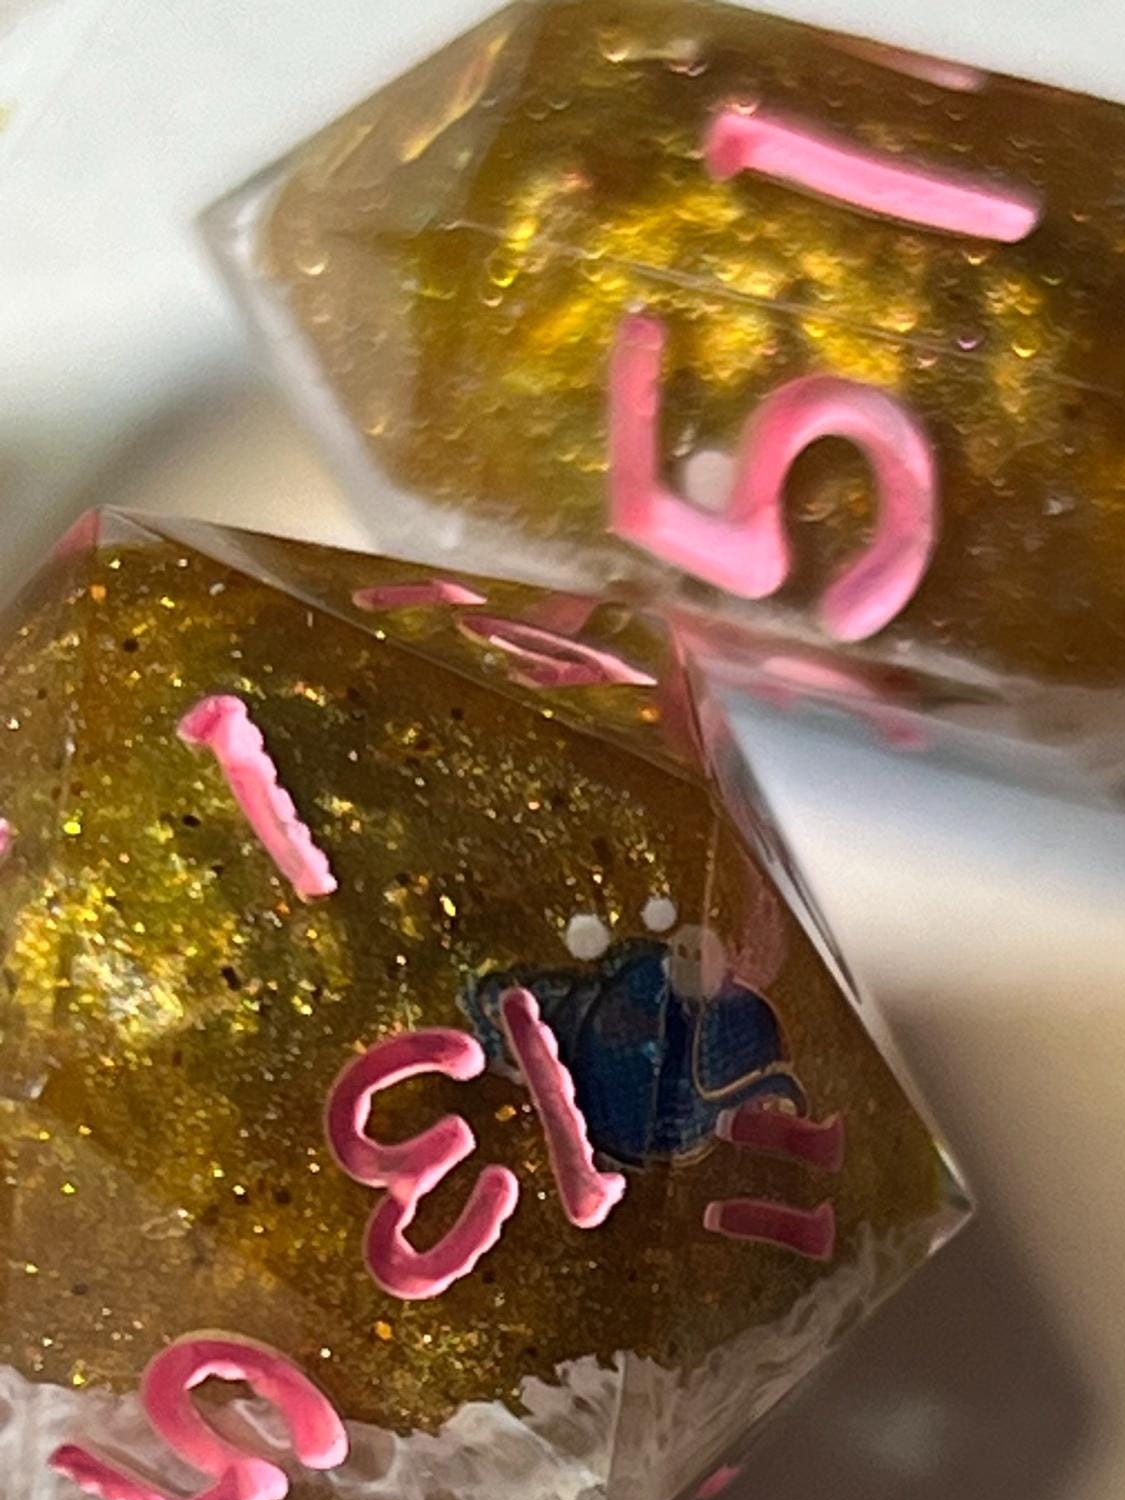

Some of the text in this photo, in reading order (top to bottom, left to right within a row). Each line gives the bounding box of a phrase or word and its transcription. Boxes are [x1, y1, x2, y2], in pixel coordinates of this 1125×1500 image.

[704, 111, 1041, 242] 1
[606, 312, 937, 642] 5
[180, 696, 336, 898] 1
[327, 990, 626, 1299] 13
